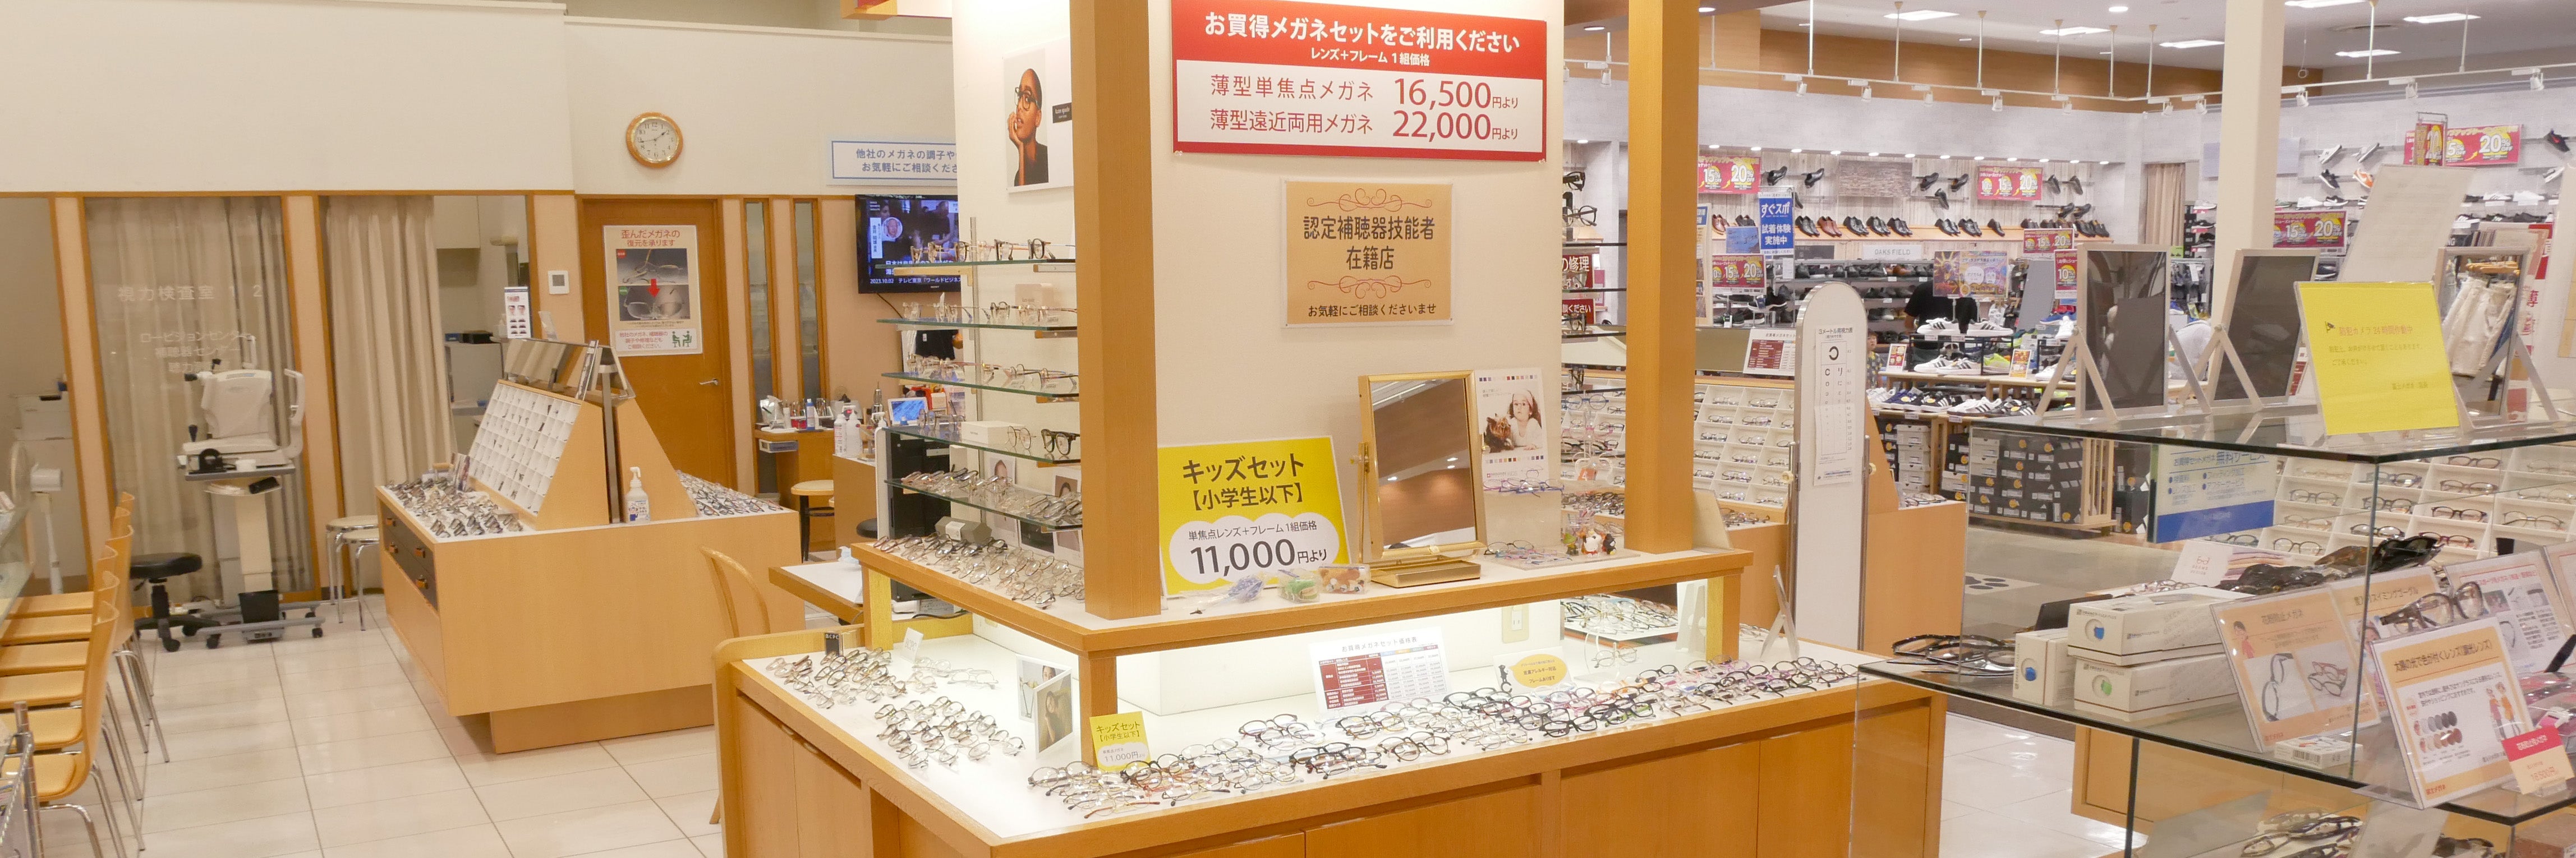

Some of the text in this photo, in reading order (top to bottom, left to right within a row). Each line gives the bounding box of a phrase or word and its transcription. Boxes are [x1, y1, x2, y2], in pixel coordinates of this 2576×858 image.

[1205, 11, 1520, 53] お買得メガネセットをご利用ください
[1391, 52, 1430, 67] 1組価格
[1210, 74, 1374, 102] 薄型単焦点メガネ
[1209, 108, 1374, 135] 薄型遠近両用メガネ
[856, 148, 956, 160] 他社のメガネの調子や
[1761, 201, 1791, 218] すぐスポ
[621, 229, 680, 239] 歪んだメガネの
[1303, 215, 1435, 240] 認定補聴器技能者
[1761, 224, 1791, 234] 試着体験
[627, 239, 676, 247] 復元を承ります
[1764, 235, 1788, 246] 実施中
[1346, 245, 1395, 270] 在籍店
[117, 286, 214, 302] 視力検査室
[1308, 303, 1437, 317] お気軽にご相談くださいませ
[1182, 453, 1304, 485] キッズセット
[1193, 482, 1303, 511] 【小学生以下】
[1285, 520, 1318, 533] 1組価格
[1096, 721, 1140, 734] キッズセット
